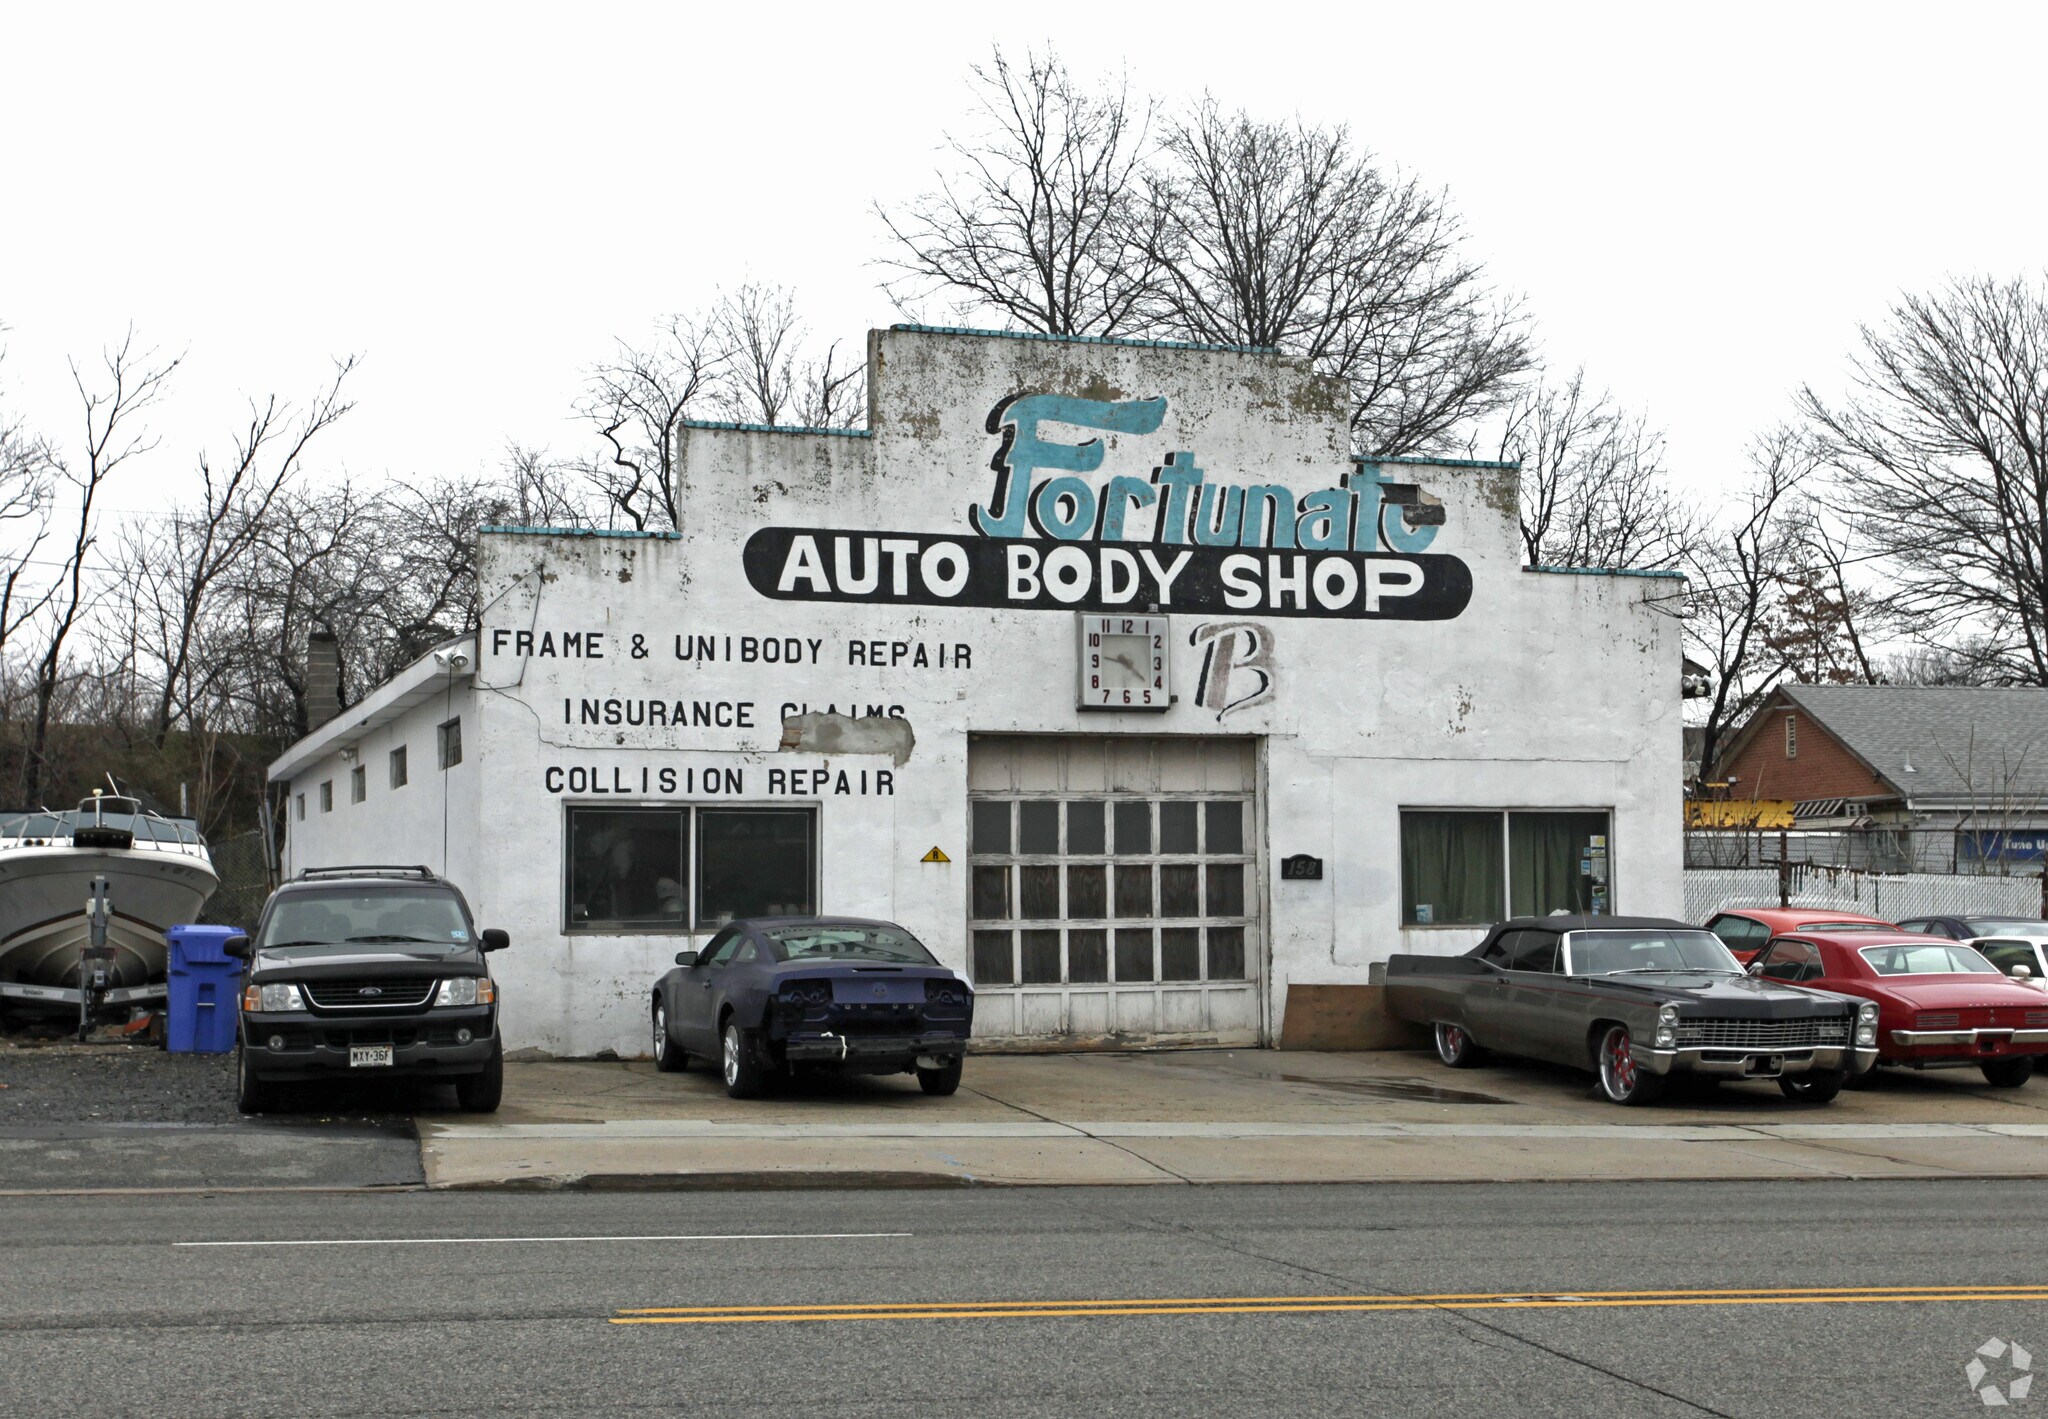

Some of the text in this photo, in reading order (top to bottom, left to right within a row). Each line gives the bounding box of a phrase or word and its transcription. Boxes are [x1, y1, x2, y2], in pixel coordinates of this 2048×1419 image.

[778, 535, 1426, 612] AUTO BODY SHOP
[1102, 619, 1149, 634] 11 12 1
[1089, 633, 1099, 647] 10
[1154, 635, 1162, 649] 2
[493, 629, 972, 669] FRAME & UNIBODY REPAIR
[1092, 655, 1099, 668] 9
[1154, 657, 1162, 670] 3
[1091, 675, 1099, 689] 8
[1154, 676, 1162, 689] 4
[1103, 690, 1151, 704] 7 6 5
[565, 698, 755, 728] INSURANCE
[545, 766, 894, 796] COLLISION REPAIR
[1288, 860, 1317, 875] 158
